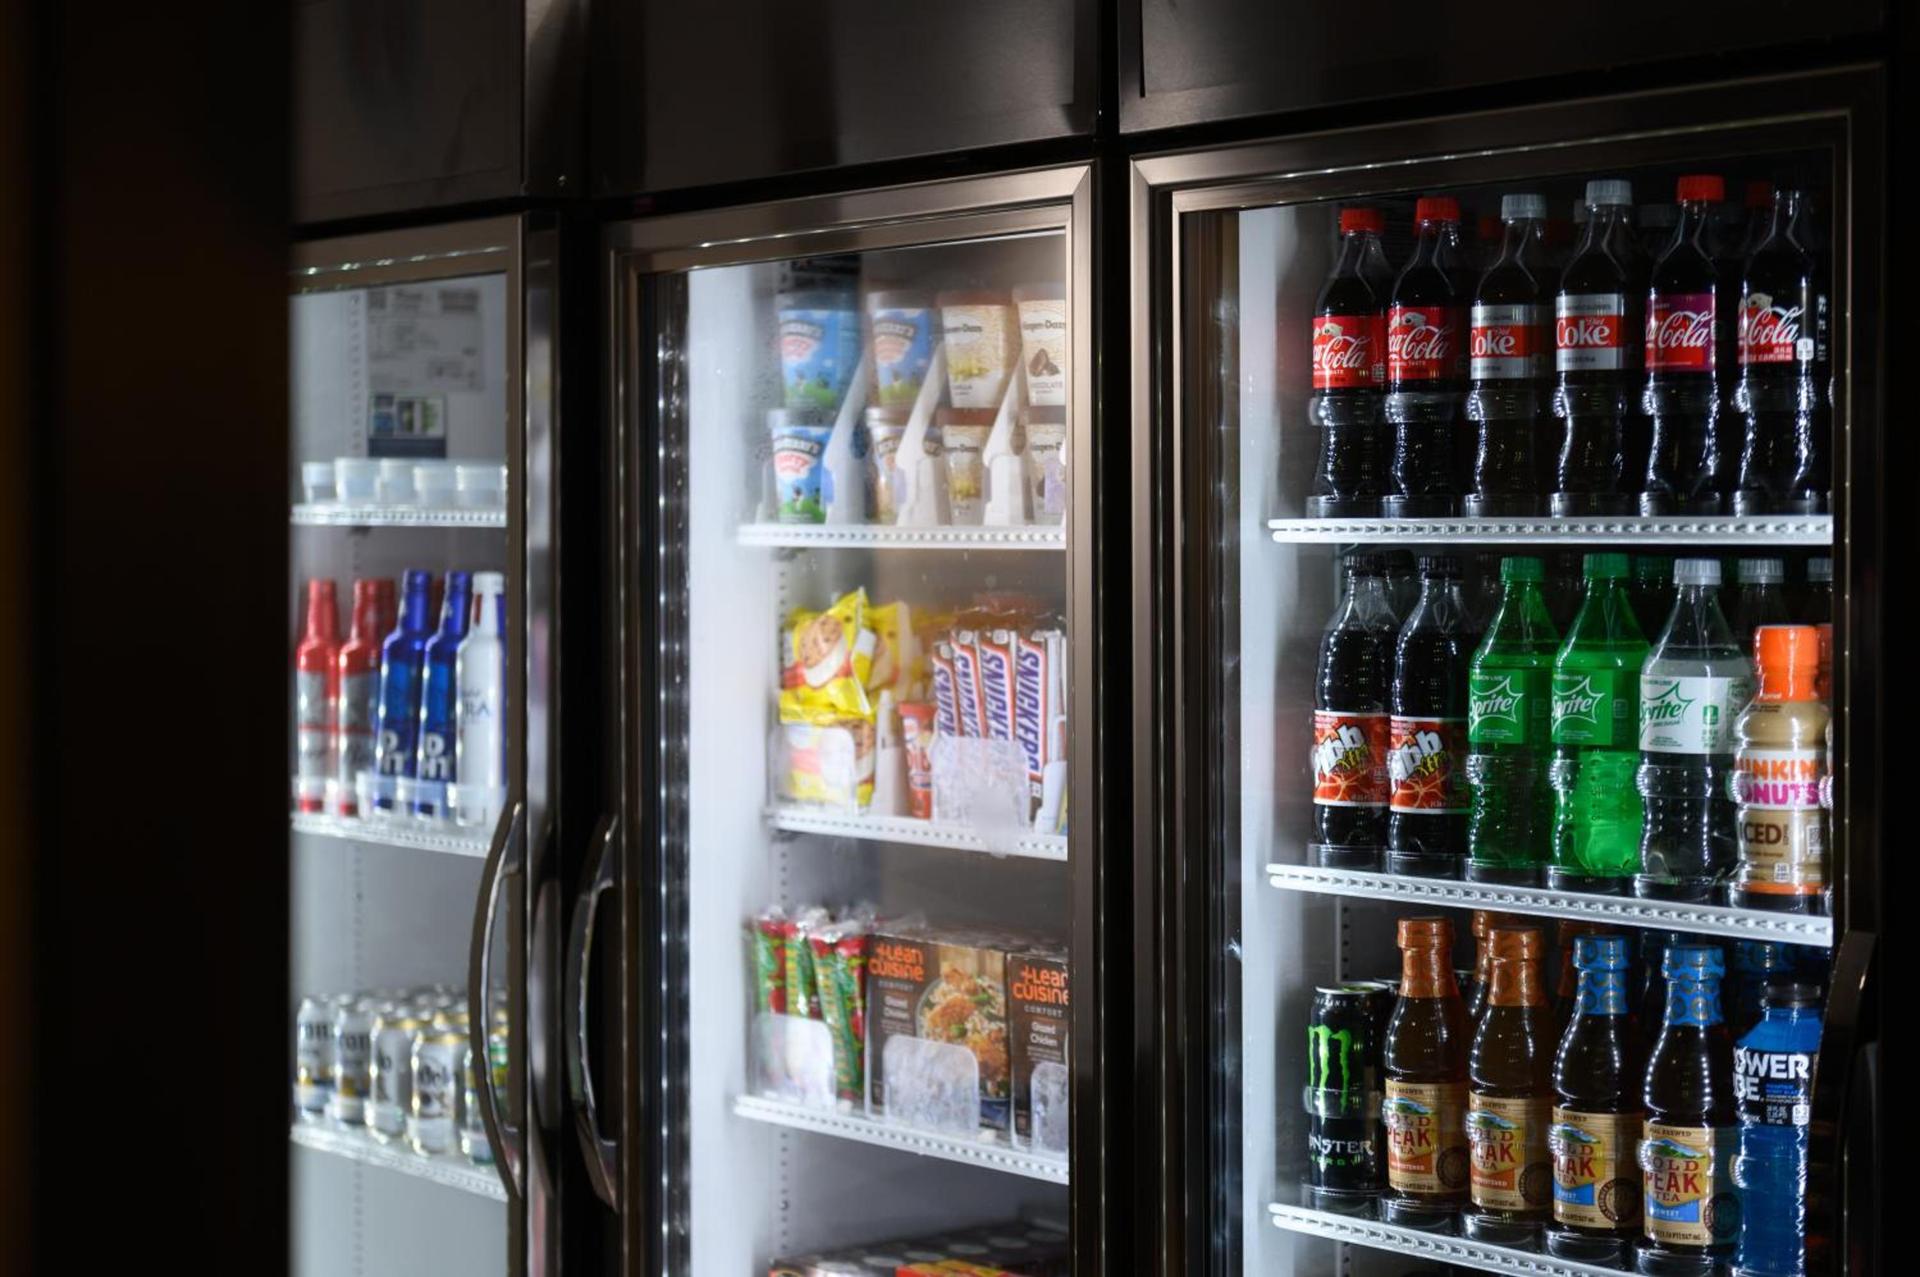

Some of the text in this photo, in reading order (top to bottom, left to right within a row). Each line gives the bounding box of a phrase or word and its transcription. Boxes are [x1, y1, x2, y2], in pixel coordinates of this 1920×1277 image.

[1471, 329, 1515, 356] Coke
[1557, 319, 1611, 347] Coke
[1470, 694, 1513, 720] Sprite
[1737, 758, 1818, 781] UNKIN
[1740, 783, 1820, 805] ONUTS
[1733, 1048, 1809, 1079] OWER
[1391, 1112, 1431, 1127] OLD
[1309, 1133, 1374, 1155] NSTER
[1653, 1156, 1700, 1172] OLD
[1645, 1171, 1700, 1193] PEAK
[1656, 1190, 1680, 1202] TEA
